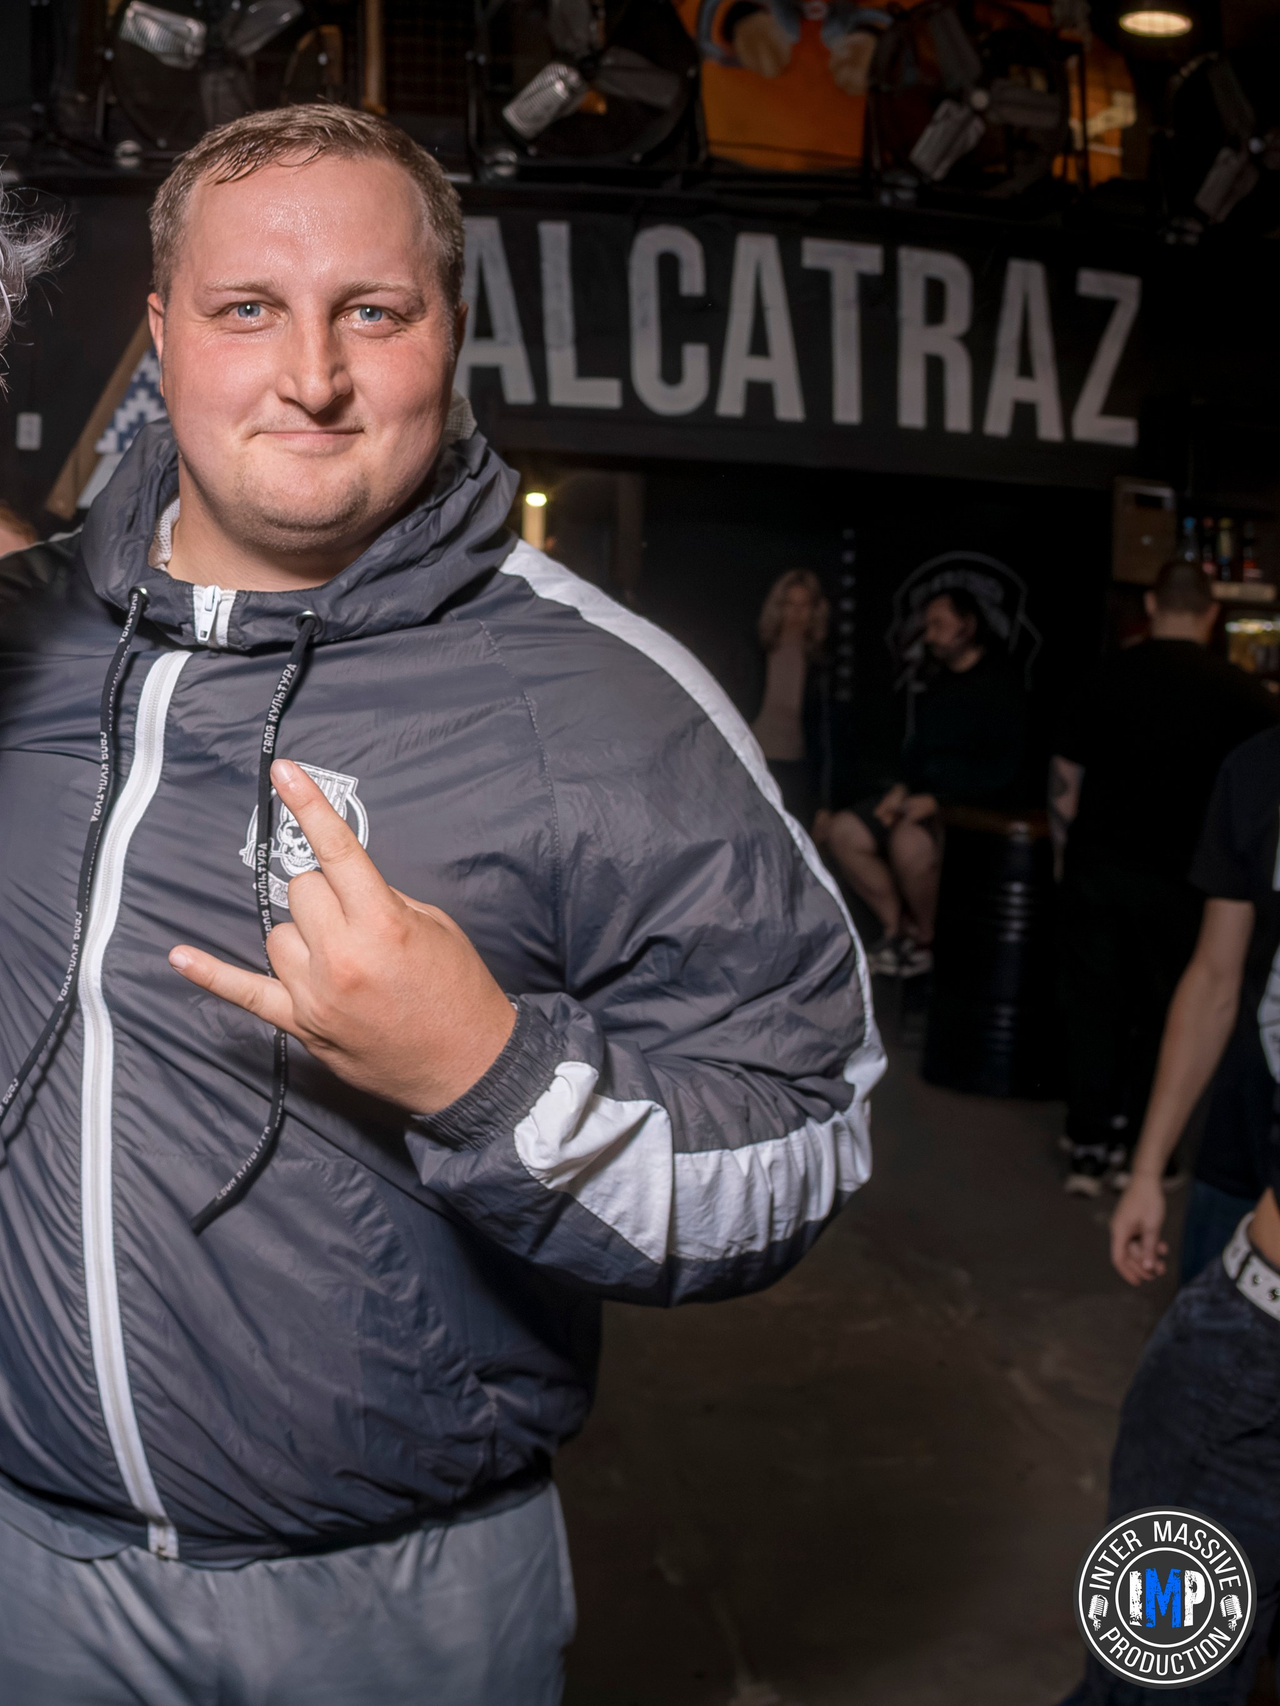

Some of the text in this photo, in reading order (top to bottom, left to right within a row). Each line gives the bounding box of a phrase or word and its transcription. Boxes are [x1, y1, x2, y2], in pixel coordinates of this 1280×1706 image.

[458, 216, 1142, 447] ALCATRAZ
[262, 663, 297, 754] СВОЯ КУЛЬТУРА
